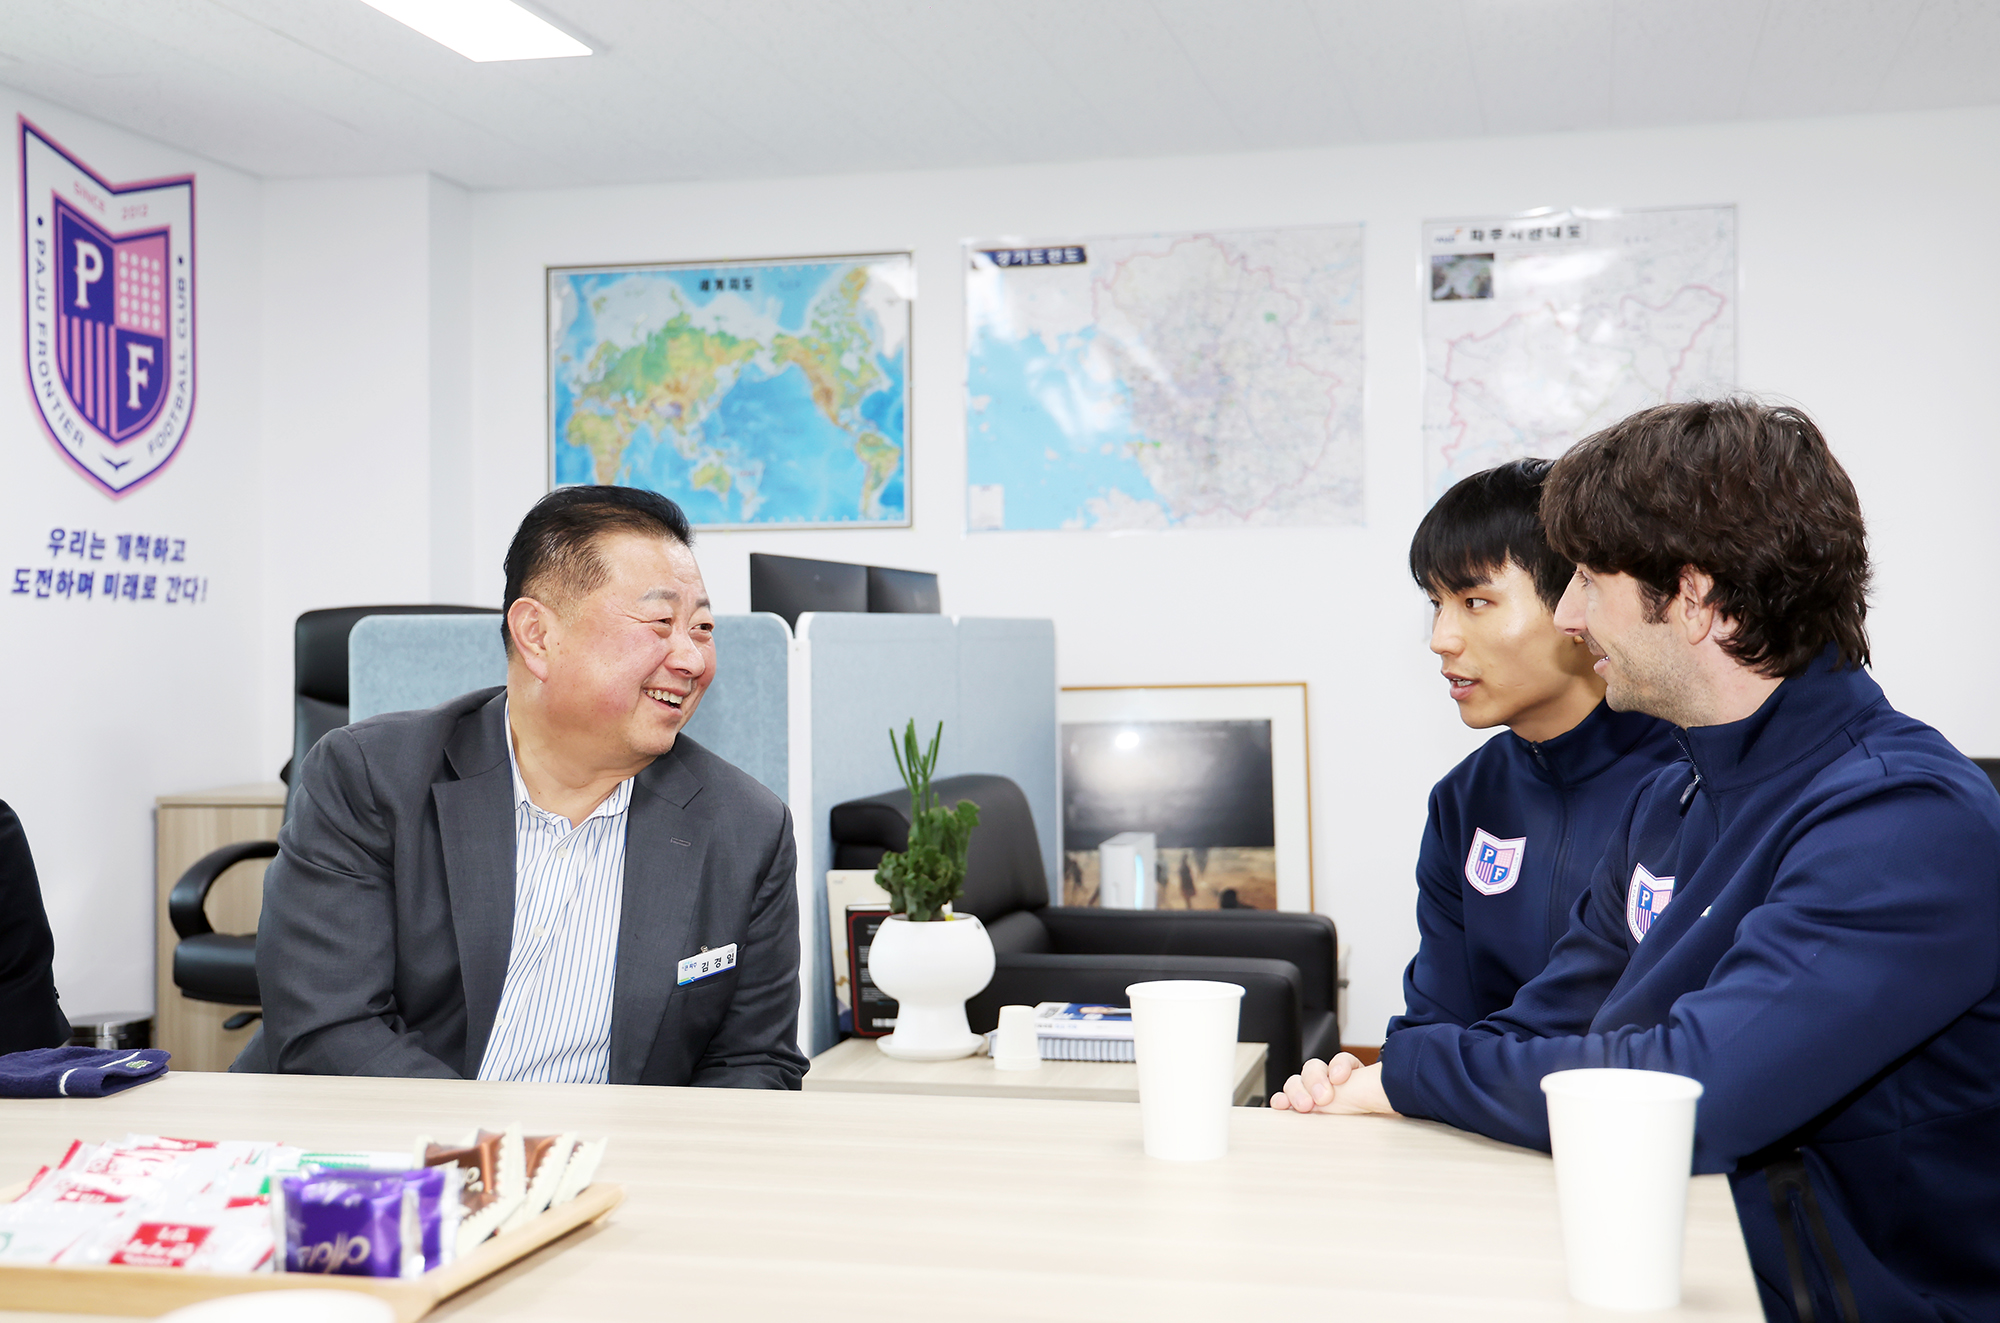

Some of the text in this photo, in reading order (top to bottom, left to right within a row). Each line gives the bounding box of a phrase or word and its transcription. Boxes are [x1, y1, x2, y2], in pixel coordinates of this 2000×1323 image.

[35, 238, 47, 312] PAJU
[74, 238, 104, 309] P
[126, 341, 155, 410] F
[47, 527, 186, 564] 우리는 개척하고
[11, 568, 208, 604] 도전하며 미래로 간다!
[1483, 848, 1495, 861] P
[1493, 867, 1506, 880] F
[1640, 889, 1651, 907] P
[701, 953, 734, 972] 김경일
